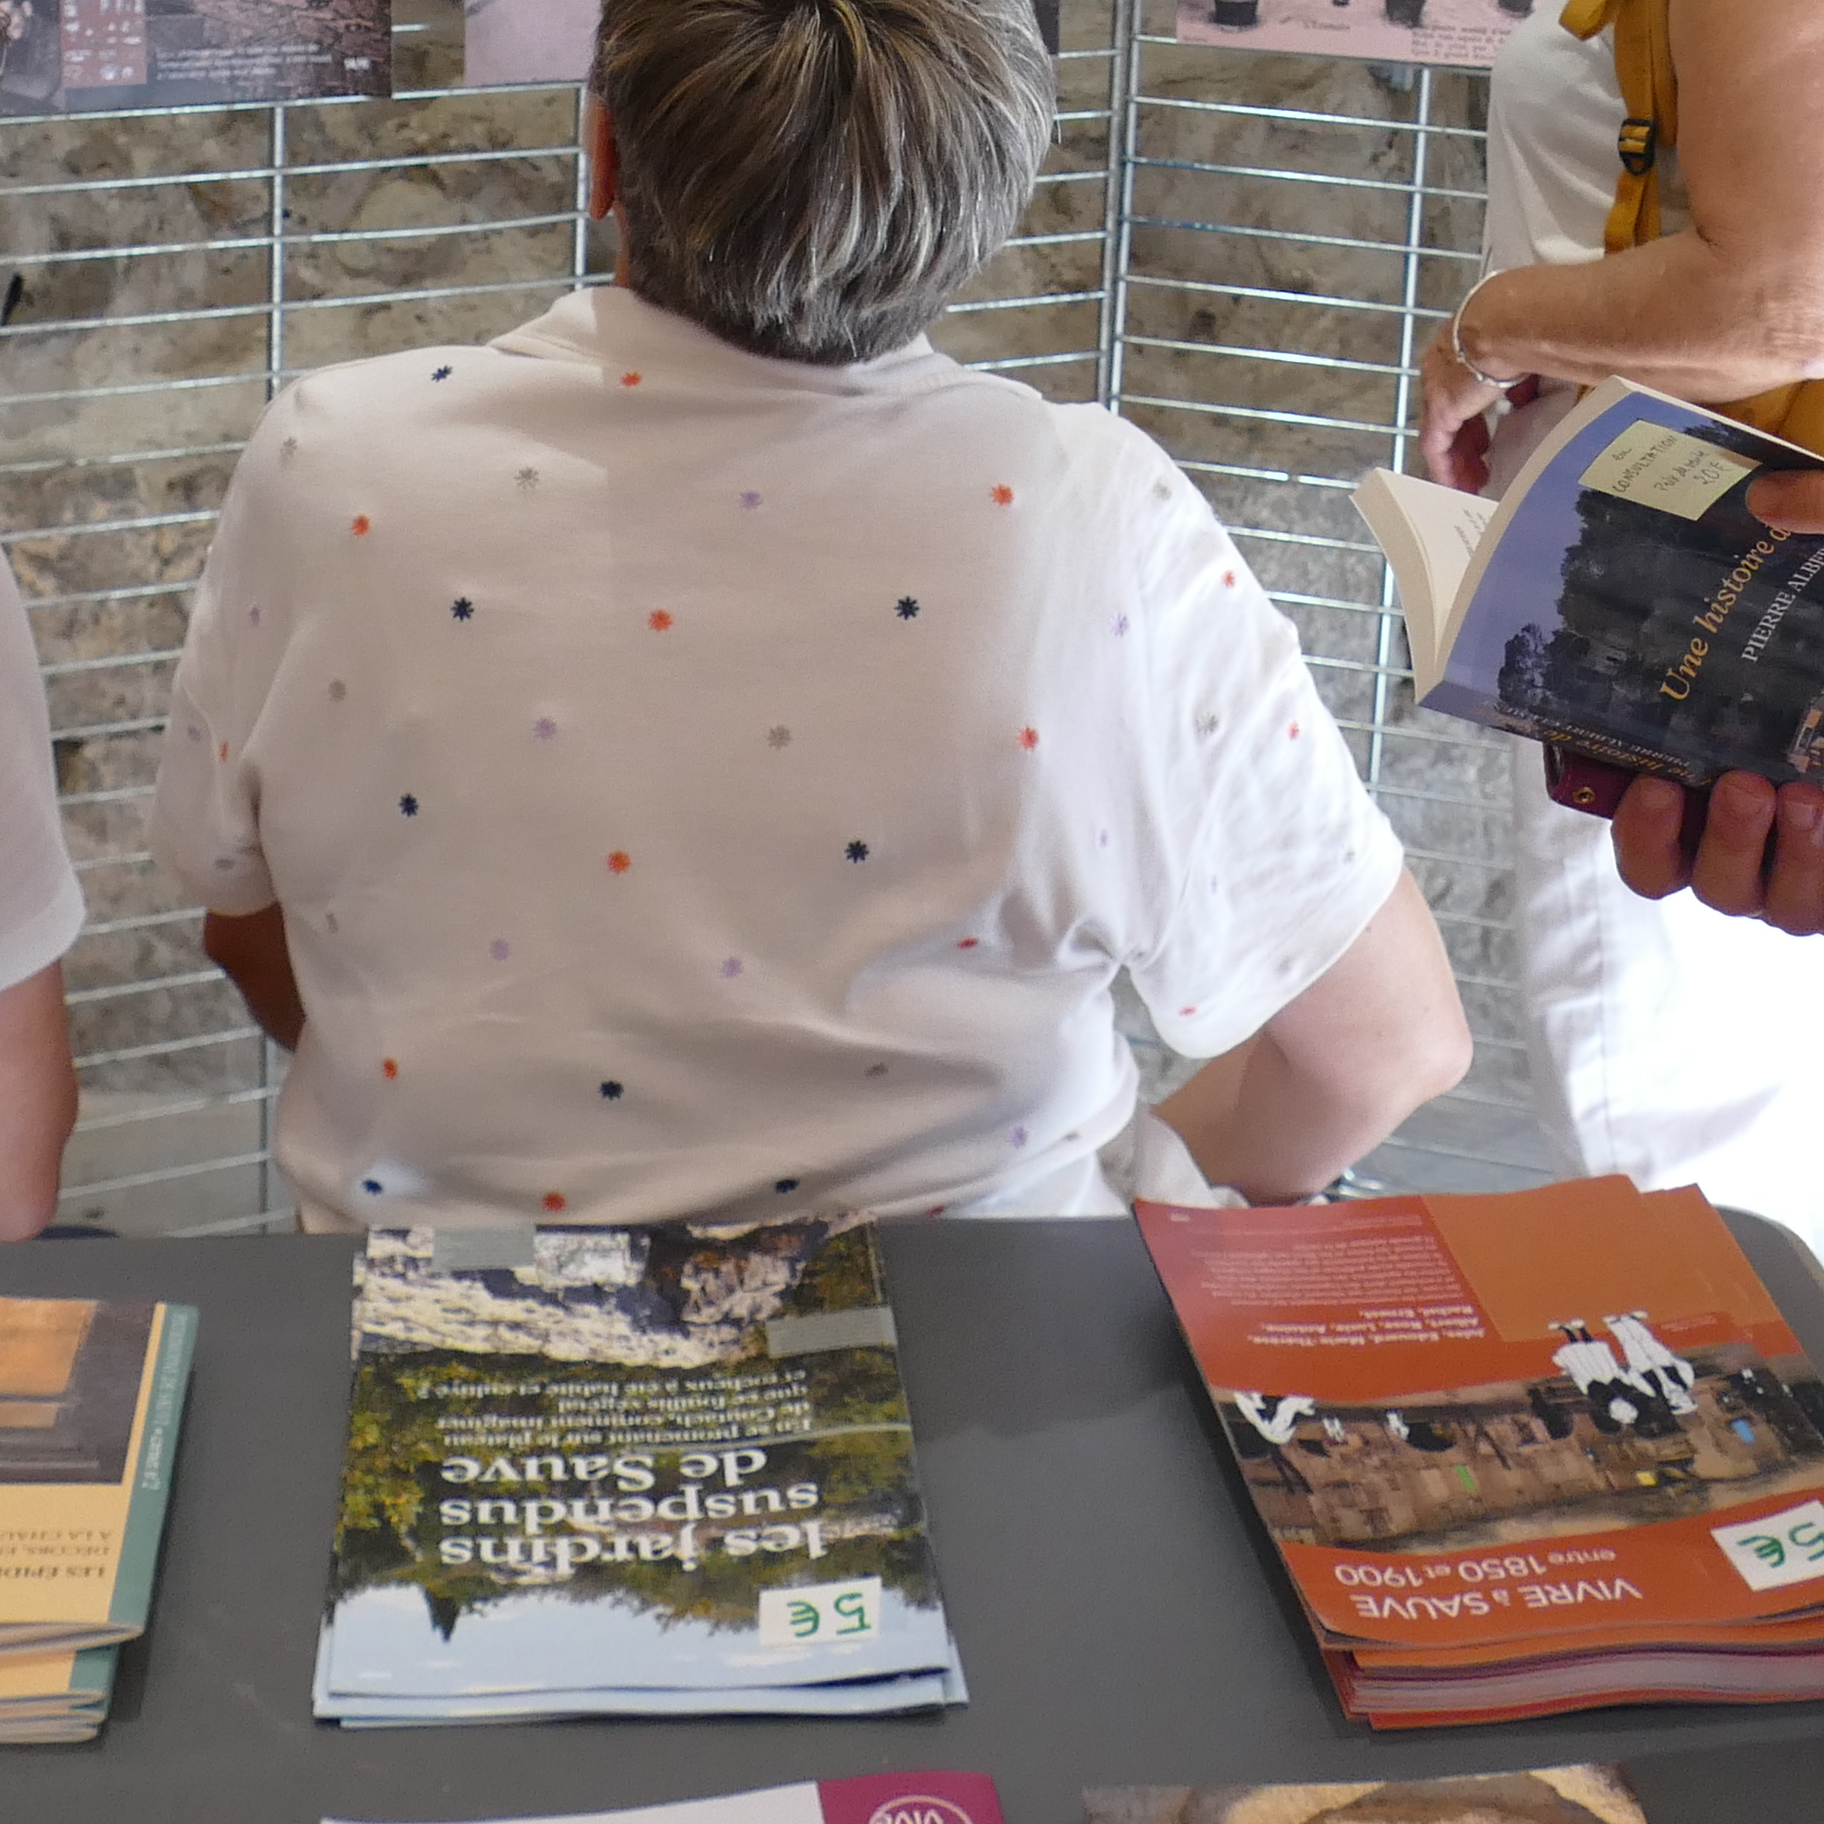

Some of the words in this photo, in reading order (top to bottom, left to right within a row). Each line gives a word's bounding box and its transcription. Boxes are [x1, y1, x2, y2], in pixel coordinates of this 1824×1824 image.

[1613, 434, 1677, 493] CONSULTATION
[1660, 637, 1709, 700] Une
[1692, 540, 1775, 634] histoire
[1741, 590, 1797, 663] PIERRE
[441, 1452, 656, 1493] Sauve
[679, 1447, 767, 1488] de
[439, 1481, 820, 1536] suspendus
[439, 1521, 699, 1576] jardins
[724, 1517, 829, 1560] les
[1548, 1548, 1617, 1567] entre
[1334, 1562, 1424, 1589] 1900
[1426, 1564, 1452, 1581] et
[1458, 1552, 1548, 1584] 1850
[1350, 1591, 1491, 1619] SAUVE
[1494, 1588, 1511, 1608] à
[1524, 1576, 1644, 1610] VIVRE
